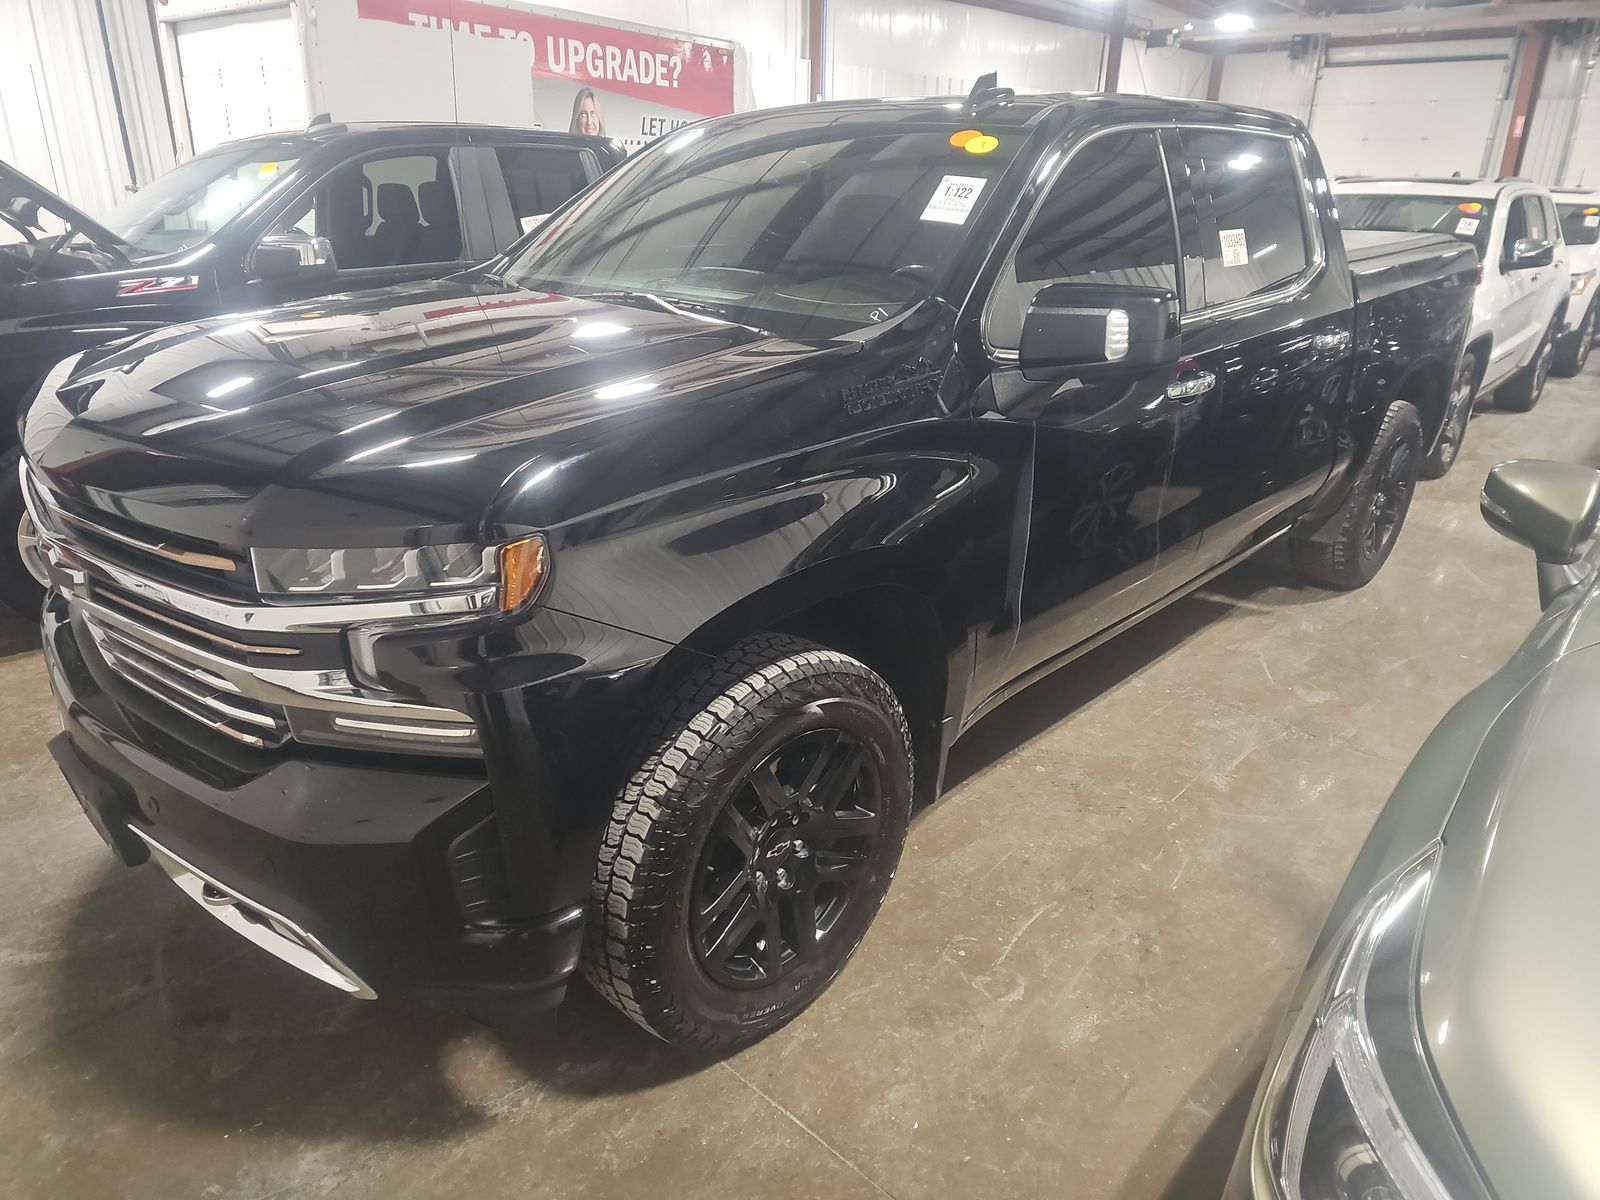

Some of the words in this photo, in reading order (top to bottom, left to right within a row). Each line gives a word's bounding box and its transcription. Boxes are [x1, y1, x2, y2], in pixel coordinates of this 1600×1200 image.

[547, 35, 683, 89] UPGRADE?
[641, 116, 666, 136] LET
[944, 186, 973, 199] 1:122
[116, 274, 199, 297] Z71
